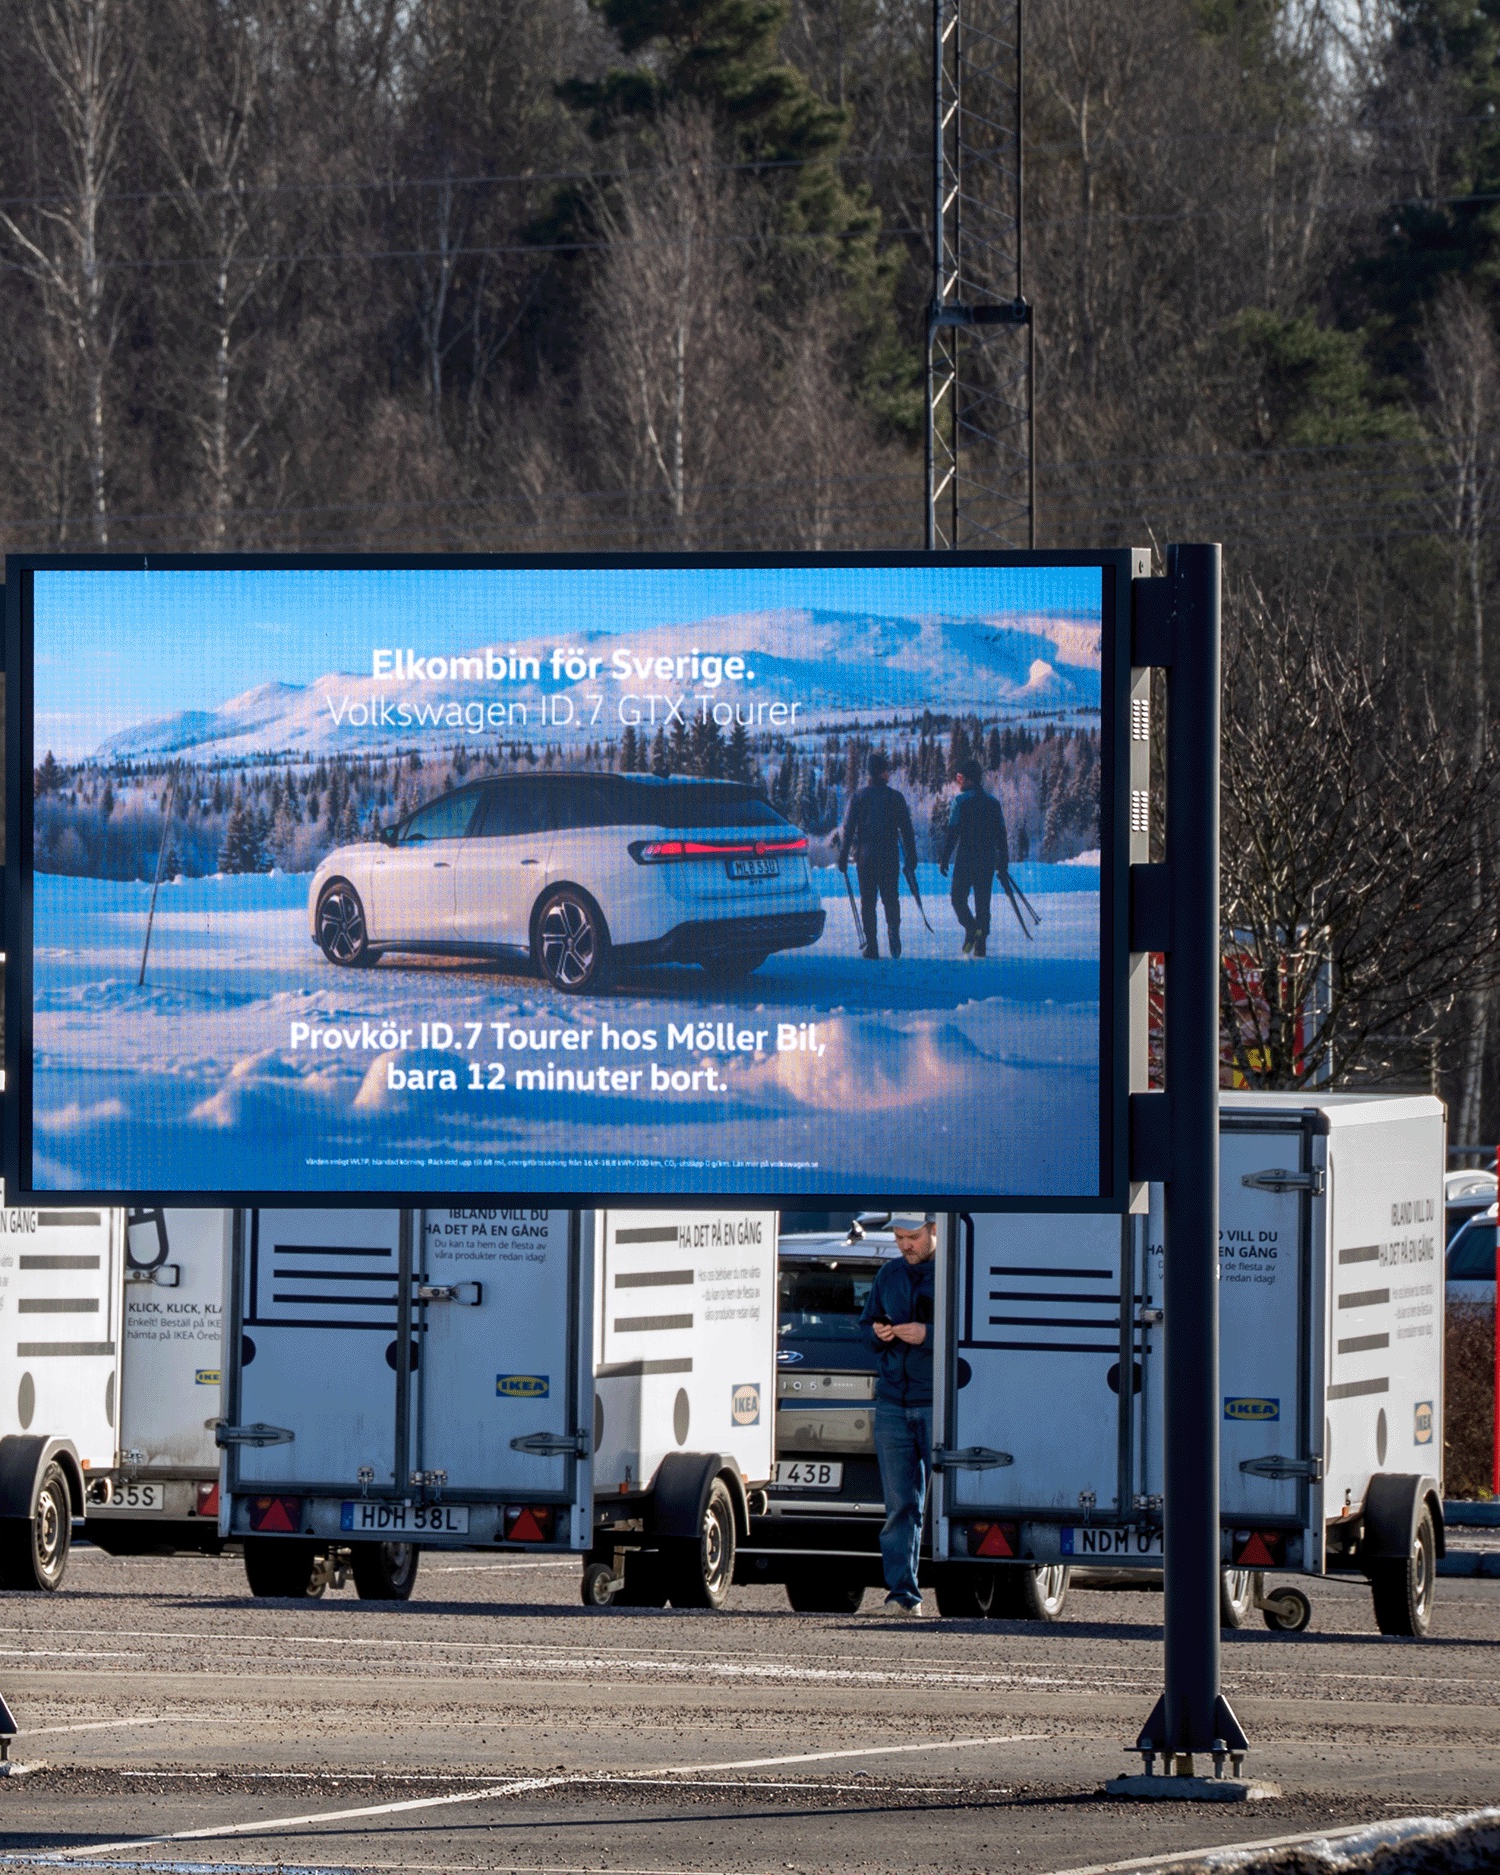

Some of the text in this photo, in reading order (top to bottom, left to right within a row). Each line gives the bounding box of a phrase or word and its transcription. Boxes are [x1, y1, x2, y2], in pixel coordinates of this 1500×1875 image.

[372, 648, 755, 688] Elkombin för Sverige.
[325, 695, 801, 733] Volkswagen ID.7 GTX Tourer
[290, 1022, 826, 1056] Provkör ID.7 Tourer hos Möller Bil,
[388, 1062, 727, 1091] bara 12 minuter bort.
[9, 1207, 36, 1233] GÅNG
[449, 1209, 548, 1221] IBLAND VILL DU
[425, 1223, 548, 1237] HA DET PÅ EN GÅNG
[679, 1217, 761, 1248] HA DET PÅ EN GÅNG
[1228, 1230, 1254, 1241] VILL
[1259, 1231, 1278, 1242] DU
[434, 1239, 546, 1250] Du kan ta hem de flesta av
[434, 1250, 546, 1264] våra produkter redan idag!
[1219, 1246, 1235, 1257] EN
[1239, 1245, 1278, 1259] GÅNG
[1225, 1262, 1275, 1272] de flesta av
[1226, 1273, 1275, 1286] redan idag!
[128, 1303, 163, 1314] KLICK,
[166, 1303, 201, 1314] KLICK,
[127, 1317, 158, 1327] Enkelt!
[160, 1318, 190, 1327] Beställ
[193, 1319, 204, 1329] på
[127, 1330, 156, 1339] hämta
[160, 1331, 171, 1341] på
[174, 1331, 194, 1339] IKEA
[502, 1381, 544, 1390] IKEA
[735, 1397, 757, 1413] IKEA
[1230, 1404, 1275, 1414] IKEA
[787, 1464, 831, 1484] 43B
[361, 1506, 458, 1531] HDH 58L
[1082, 1530, 1164, 1554] NDM 01
